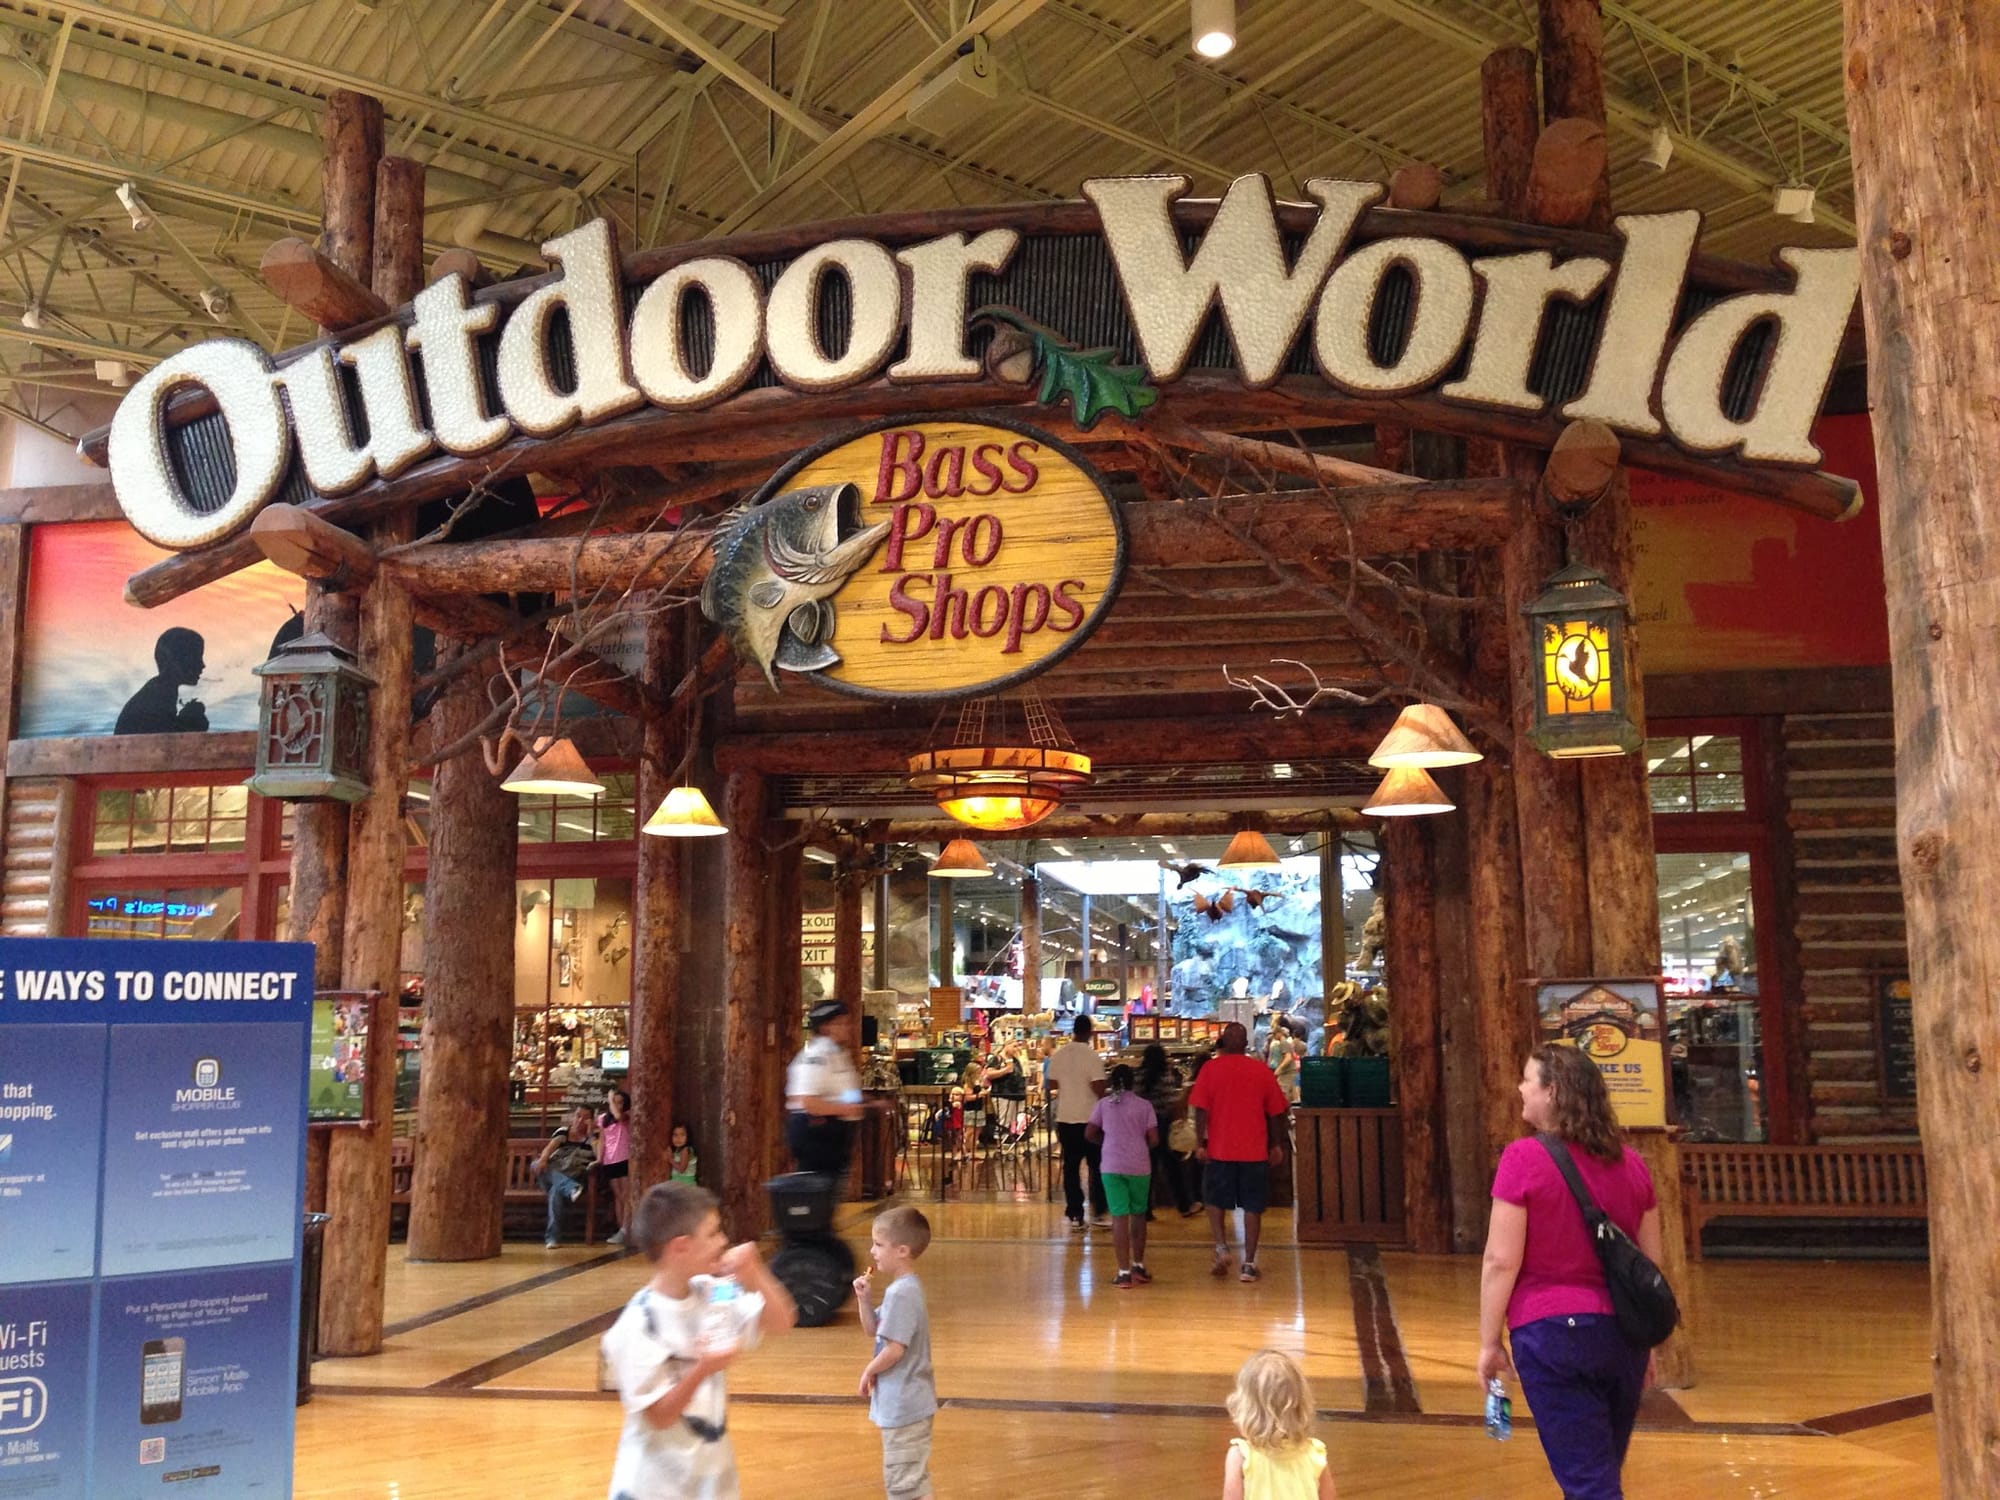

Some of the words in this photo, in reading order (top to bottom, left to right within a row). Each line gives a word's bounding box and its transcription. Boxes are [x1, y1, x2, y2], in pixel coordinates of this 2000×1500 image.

[108, 217, 1021, 548] Outdoor
[1081, 172, 1861, 464] World
[870, 429, 1040, 504] Bass
[878, 502, 1004, 574] Pro
[879, 573, 1086, 655] Shops
[15, 970, 105, 1001] WAYS
[115, 971, 155, 1001] TO
[163, 972, 298, 1001] CONNECT
[1624, 1063, 1642, 1073] US
[3, 1083, 33, 1099] that
[175, 1087, 236, 1102] MOBILE
[150, 1301, 188, 1312] Personal
[189, 1297, 230, 1309] Shopping
[231, 1292, 268, 1304] Assistant
[7, 1440, 40, 1457] Malls
